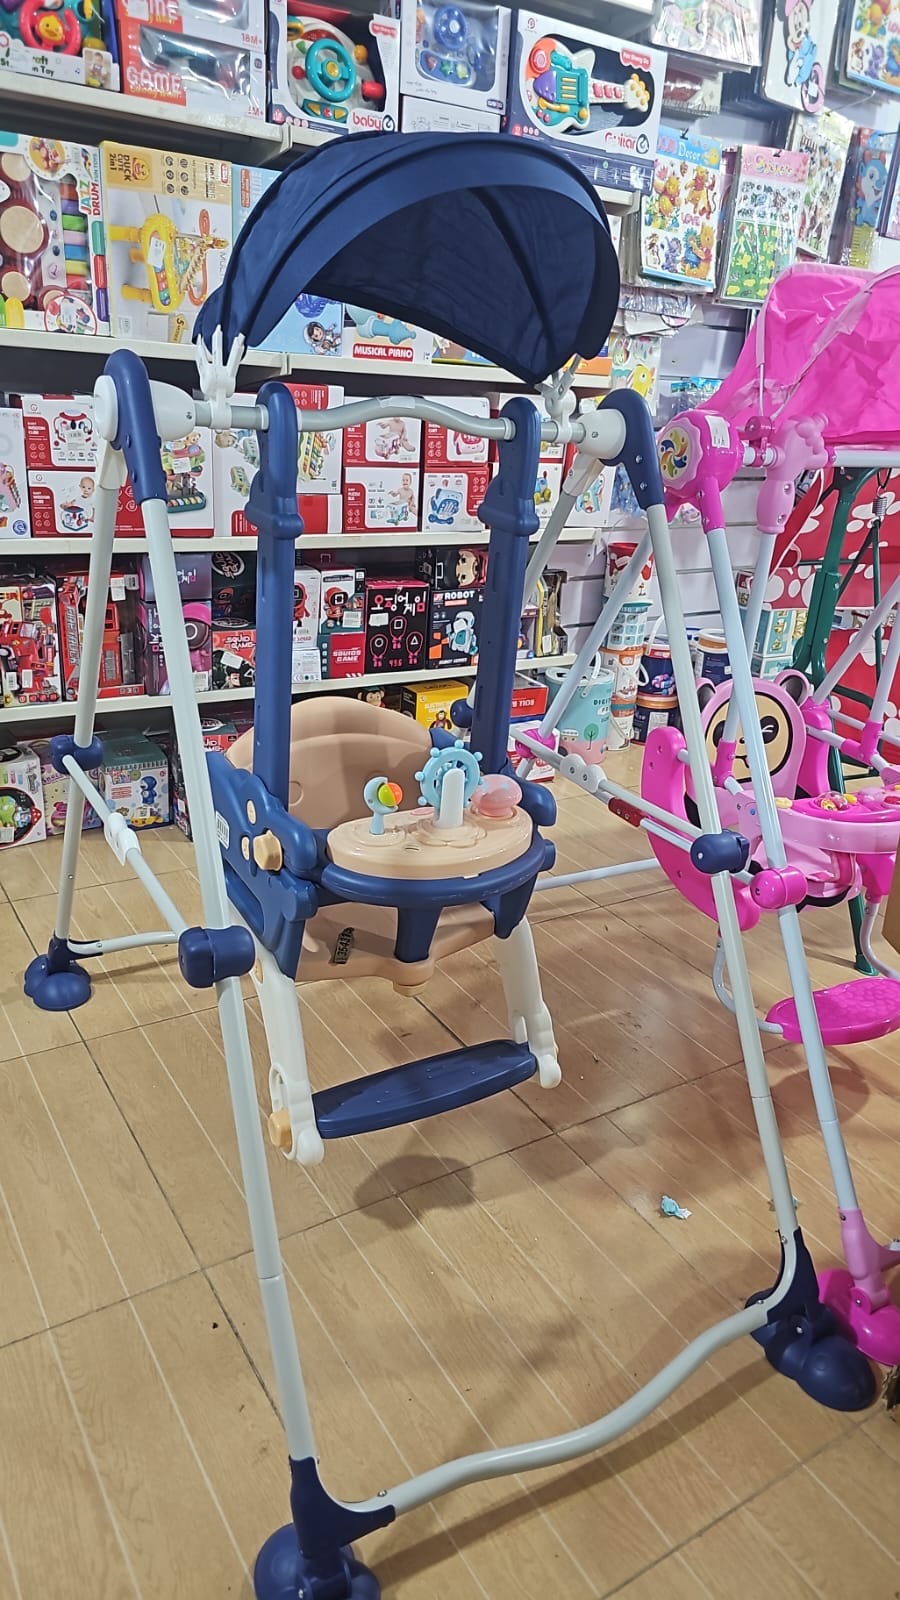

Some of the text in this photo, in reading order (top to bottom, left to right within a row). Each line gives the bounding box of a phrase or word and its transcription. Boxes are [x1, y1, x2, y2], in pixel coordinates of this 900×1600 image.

[353, 112, 381, 131] baby
[678, 141, 701, 161] Decor
[123, 154, 131, 182] DUCK
[79, 181, 91, 215] JAZZ
[89, 182, 101, 216] DRUM
[681, 212, 700, 227] LOVE
[354, 345, 413, 359] MUSICAL PIANO
[444, 590, 476, 600] ROBOT
